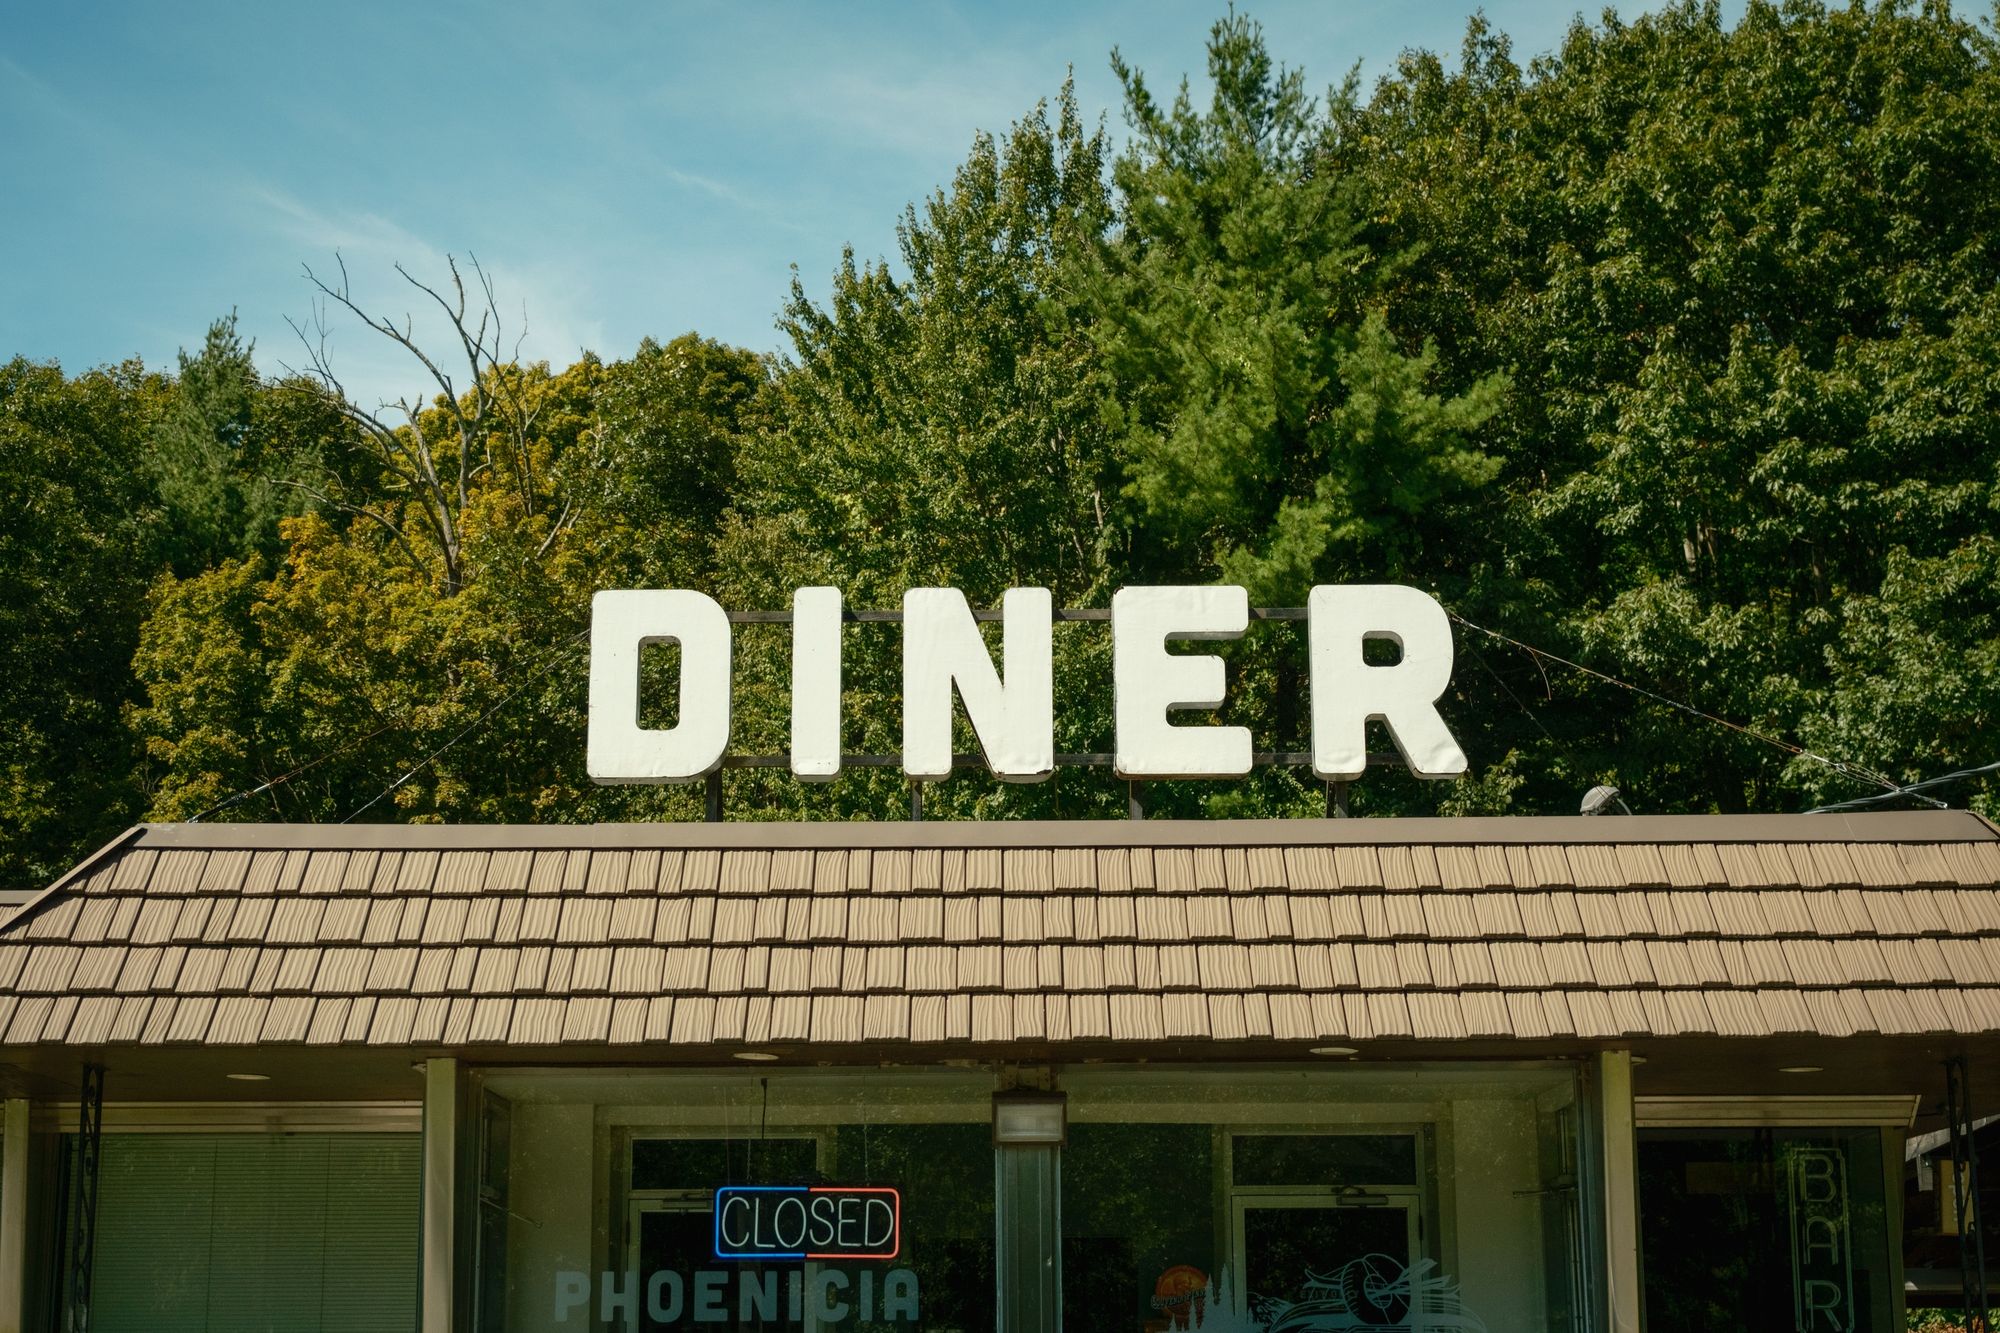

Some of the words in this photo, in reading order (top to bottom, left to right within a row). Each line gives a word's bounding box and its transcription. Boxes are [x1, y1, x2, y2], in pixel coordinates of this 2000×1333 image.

[587, 584, 1469, 784] DINER
[721, 1196, 895, 1249] CLOSED
[1800, 1154, 1842, 1333] BAR
[554, 1268, 920, 1323] PHOENICIA
